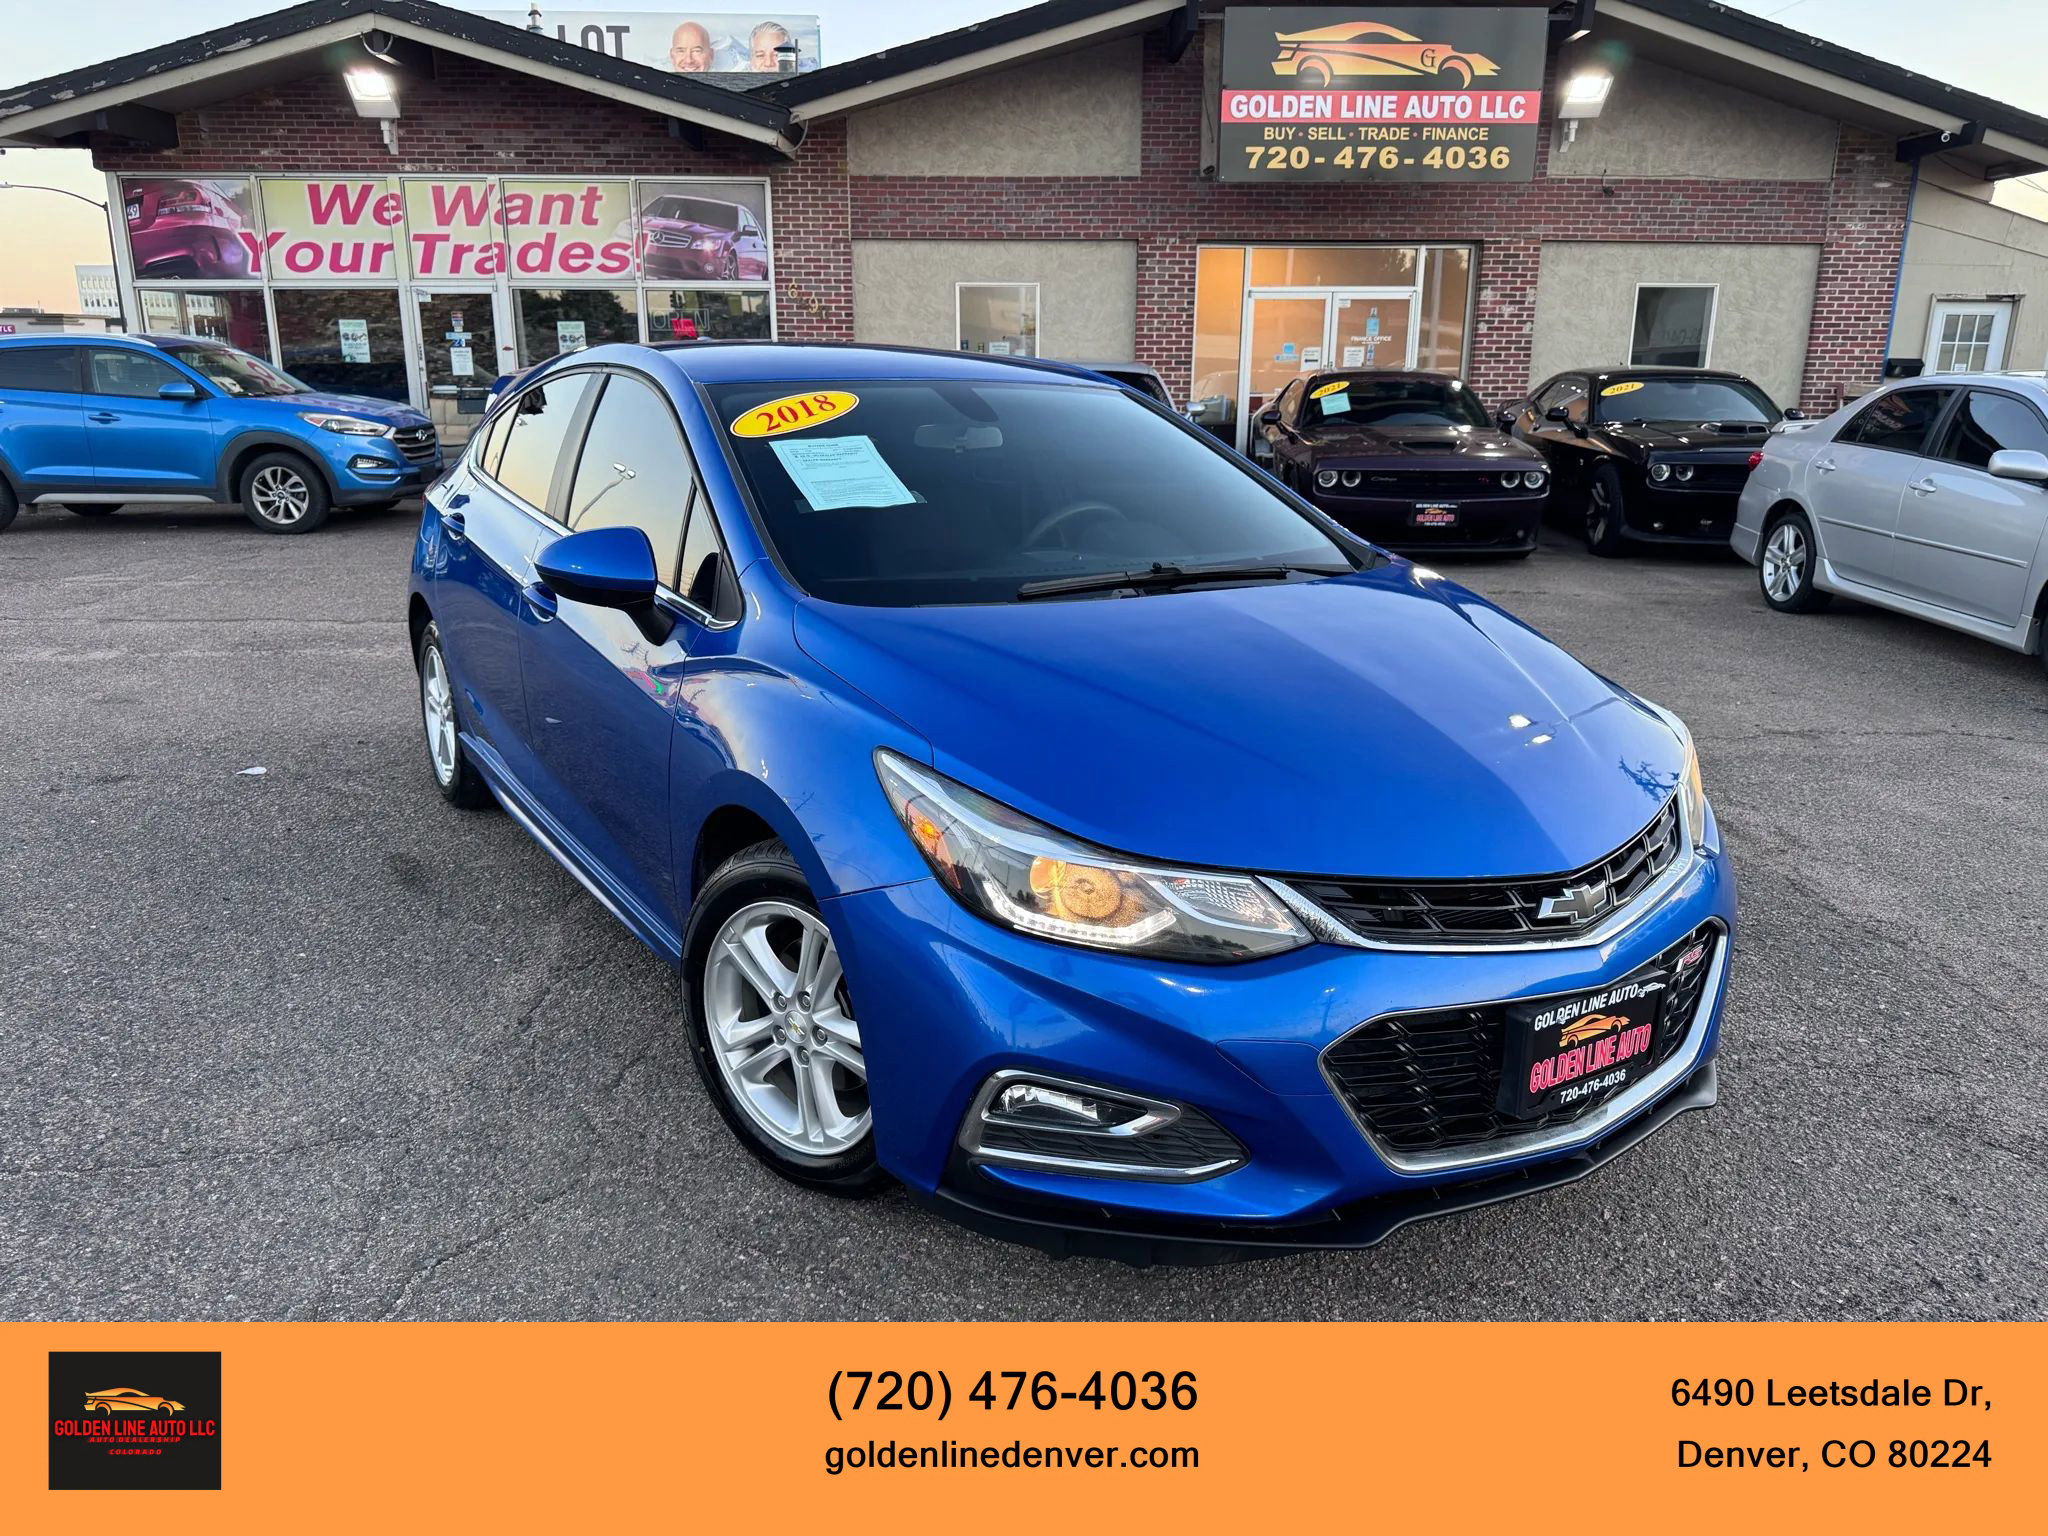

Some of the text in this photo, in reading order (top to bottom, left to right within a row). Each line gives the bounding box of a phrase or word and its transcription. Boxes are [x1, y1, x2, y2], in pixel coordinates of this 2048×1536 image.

[1230, 95, 1526, 119] GOLDEN LINE AUTO LLC
[1263, 127, 1489, 141] BUY SELL TRADE FINANCE
[306, 184, 604, 227] We Want
[238, 231, 649, 275] Your Trades!
[1611, 383, 1635, 394] 2021
[756, 394, 837, 432] 2018
[1534, 983, 1639, 1032] GOLDEN LINE AUTO
[1529, 1023, 1652, 1094] GOLDEN LINE AUTO
[1560, 1069, 1627, 1104] 720-476-4036
